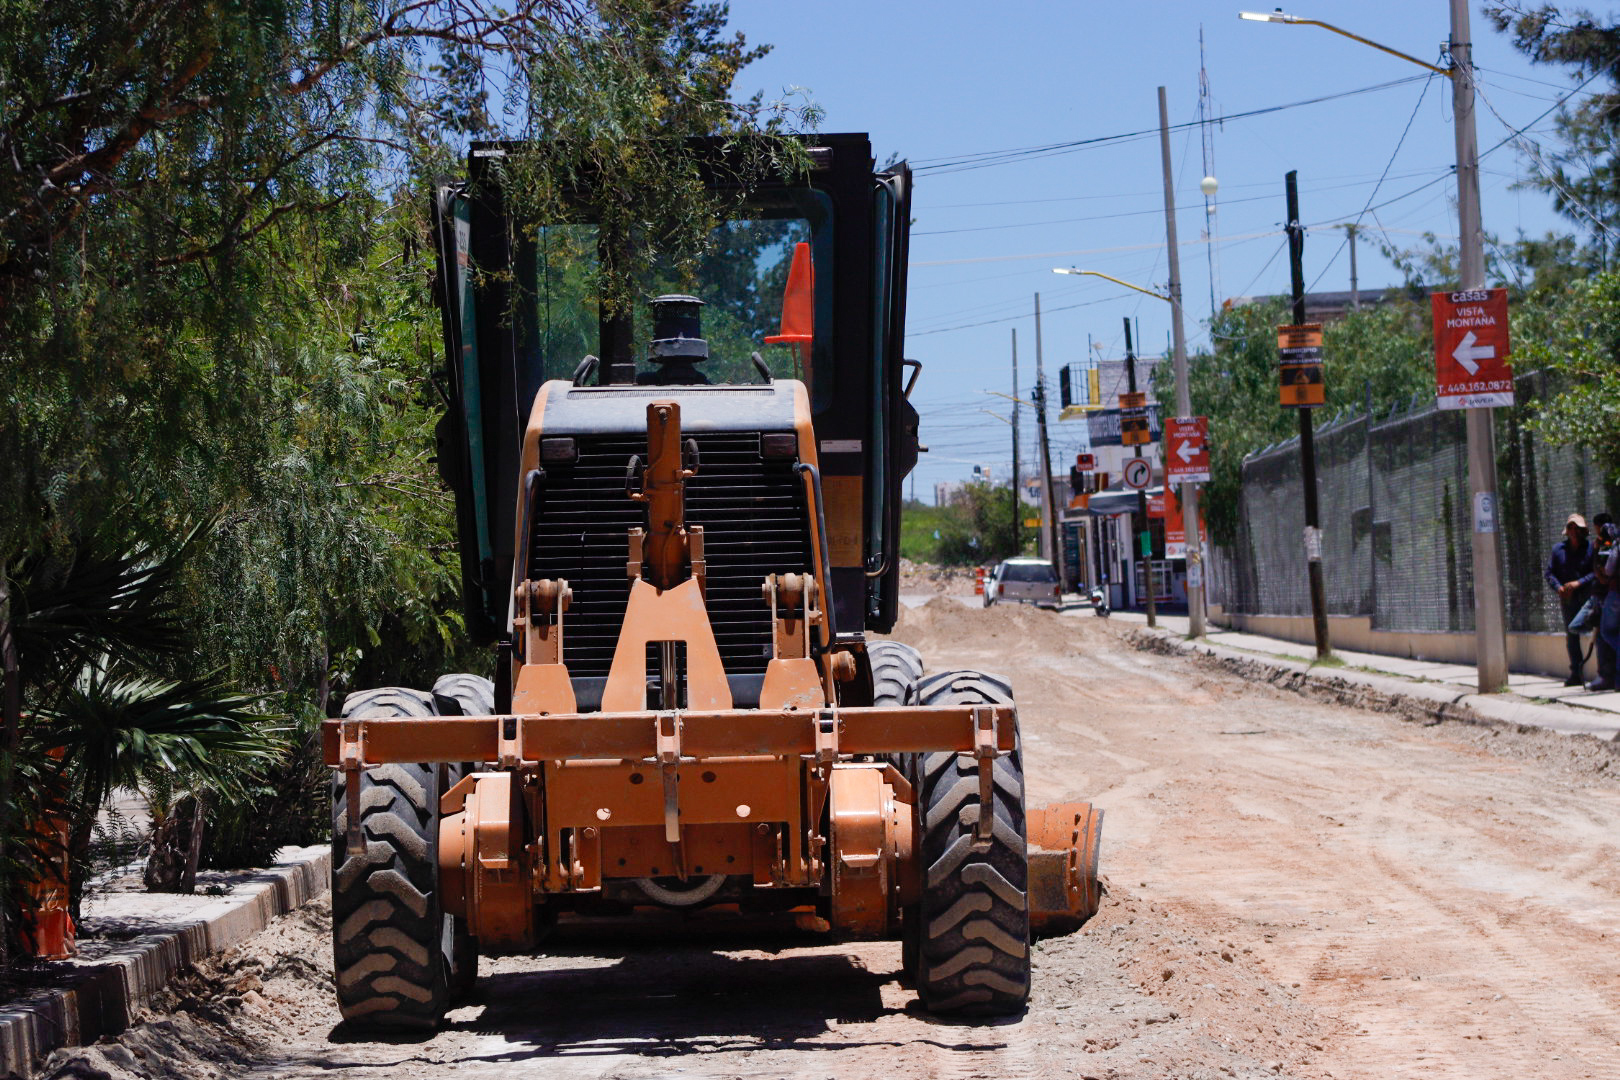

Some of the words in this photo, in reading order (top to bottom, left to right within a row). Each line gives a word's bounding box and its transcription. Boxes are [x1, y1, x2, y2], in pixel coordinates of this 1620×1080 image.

[1452, 291, 1488, 302] casas
[1456, 307, 1484, 316] VISTA
[1447, 317, 1495, 328] MONTAÑA
